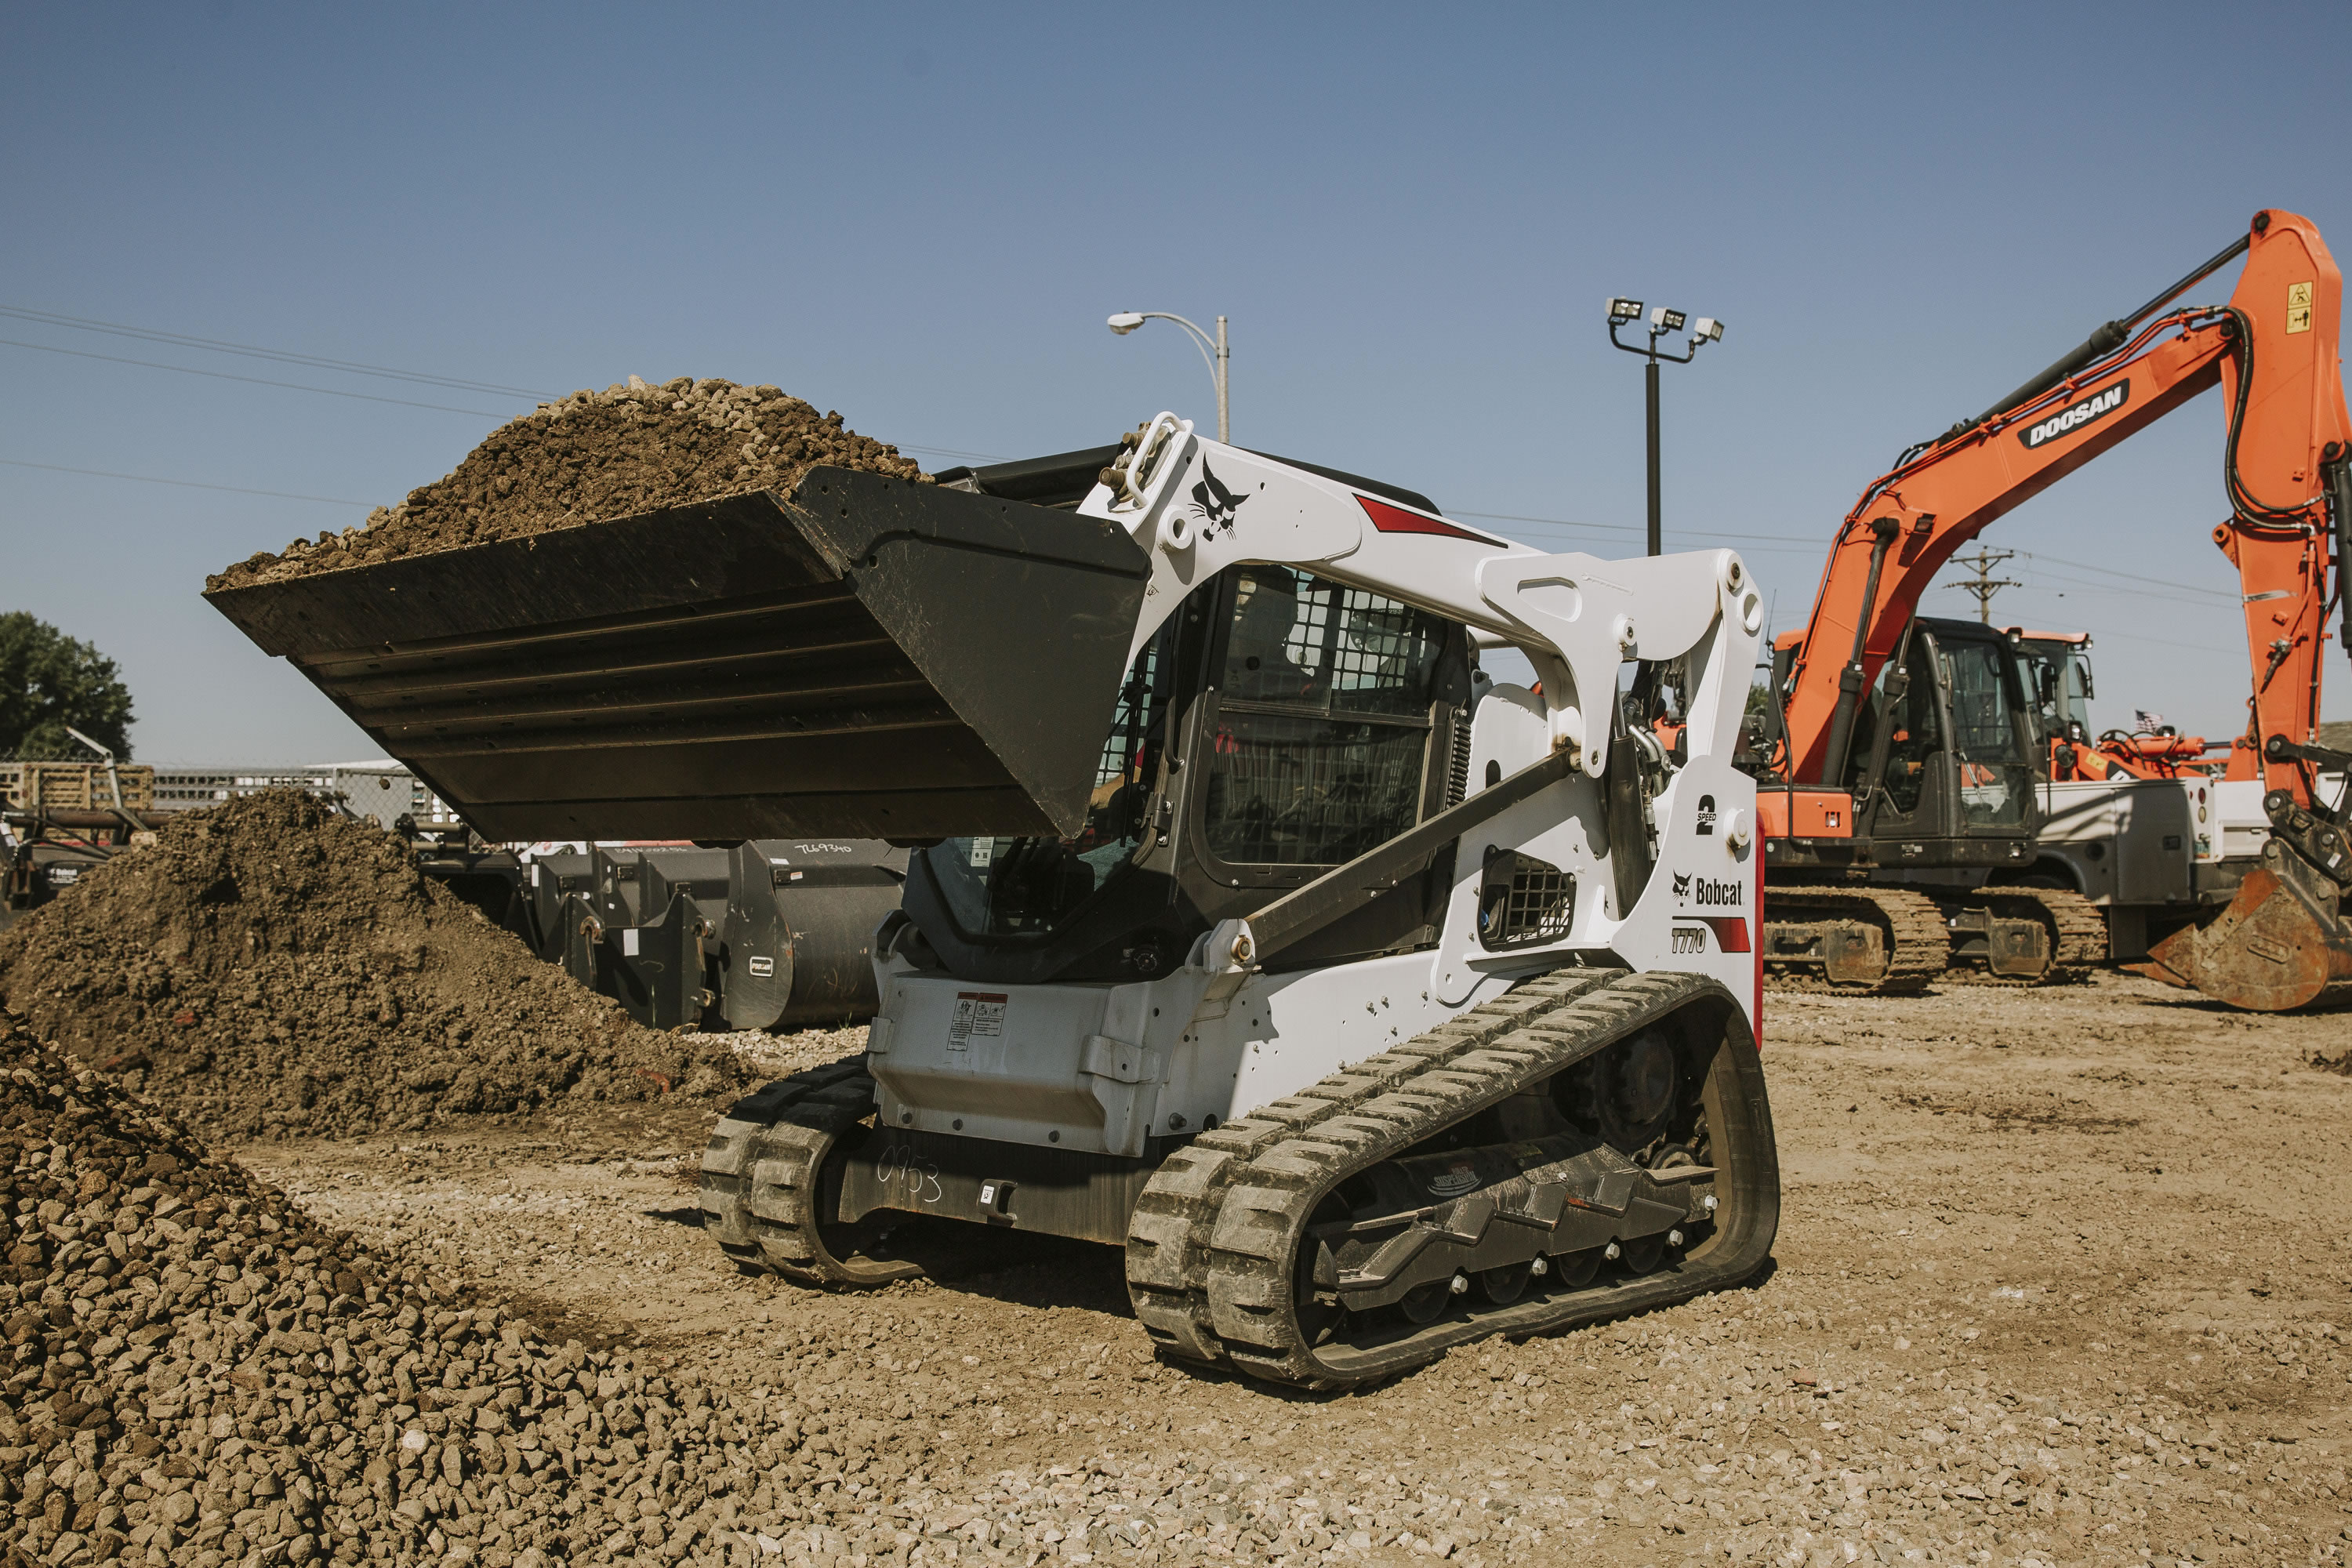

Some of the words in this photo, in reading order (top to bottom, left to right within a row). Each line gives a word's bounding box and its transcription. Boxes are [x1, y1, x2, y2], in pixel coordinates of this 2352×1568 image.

[2030, 386, 2122, 446] DOOSAN
[1696, 794, 1715, 835] 2
[1697, 811, 1717, 822] SPEED
[1696, 877, 1742, 906] Bobcat
[1671, 927, 1706, 954] T770
[877, 1145, 942, 1202] 0953
[1433, 1171, 1477, 1187] SUSPENSION
